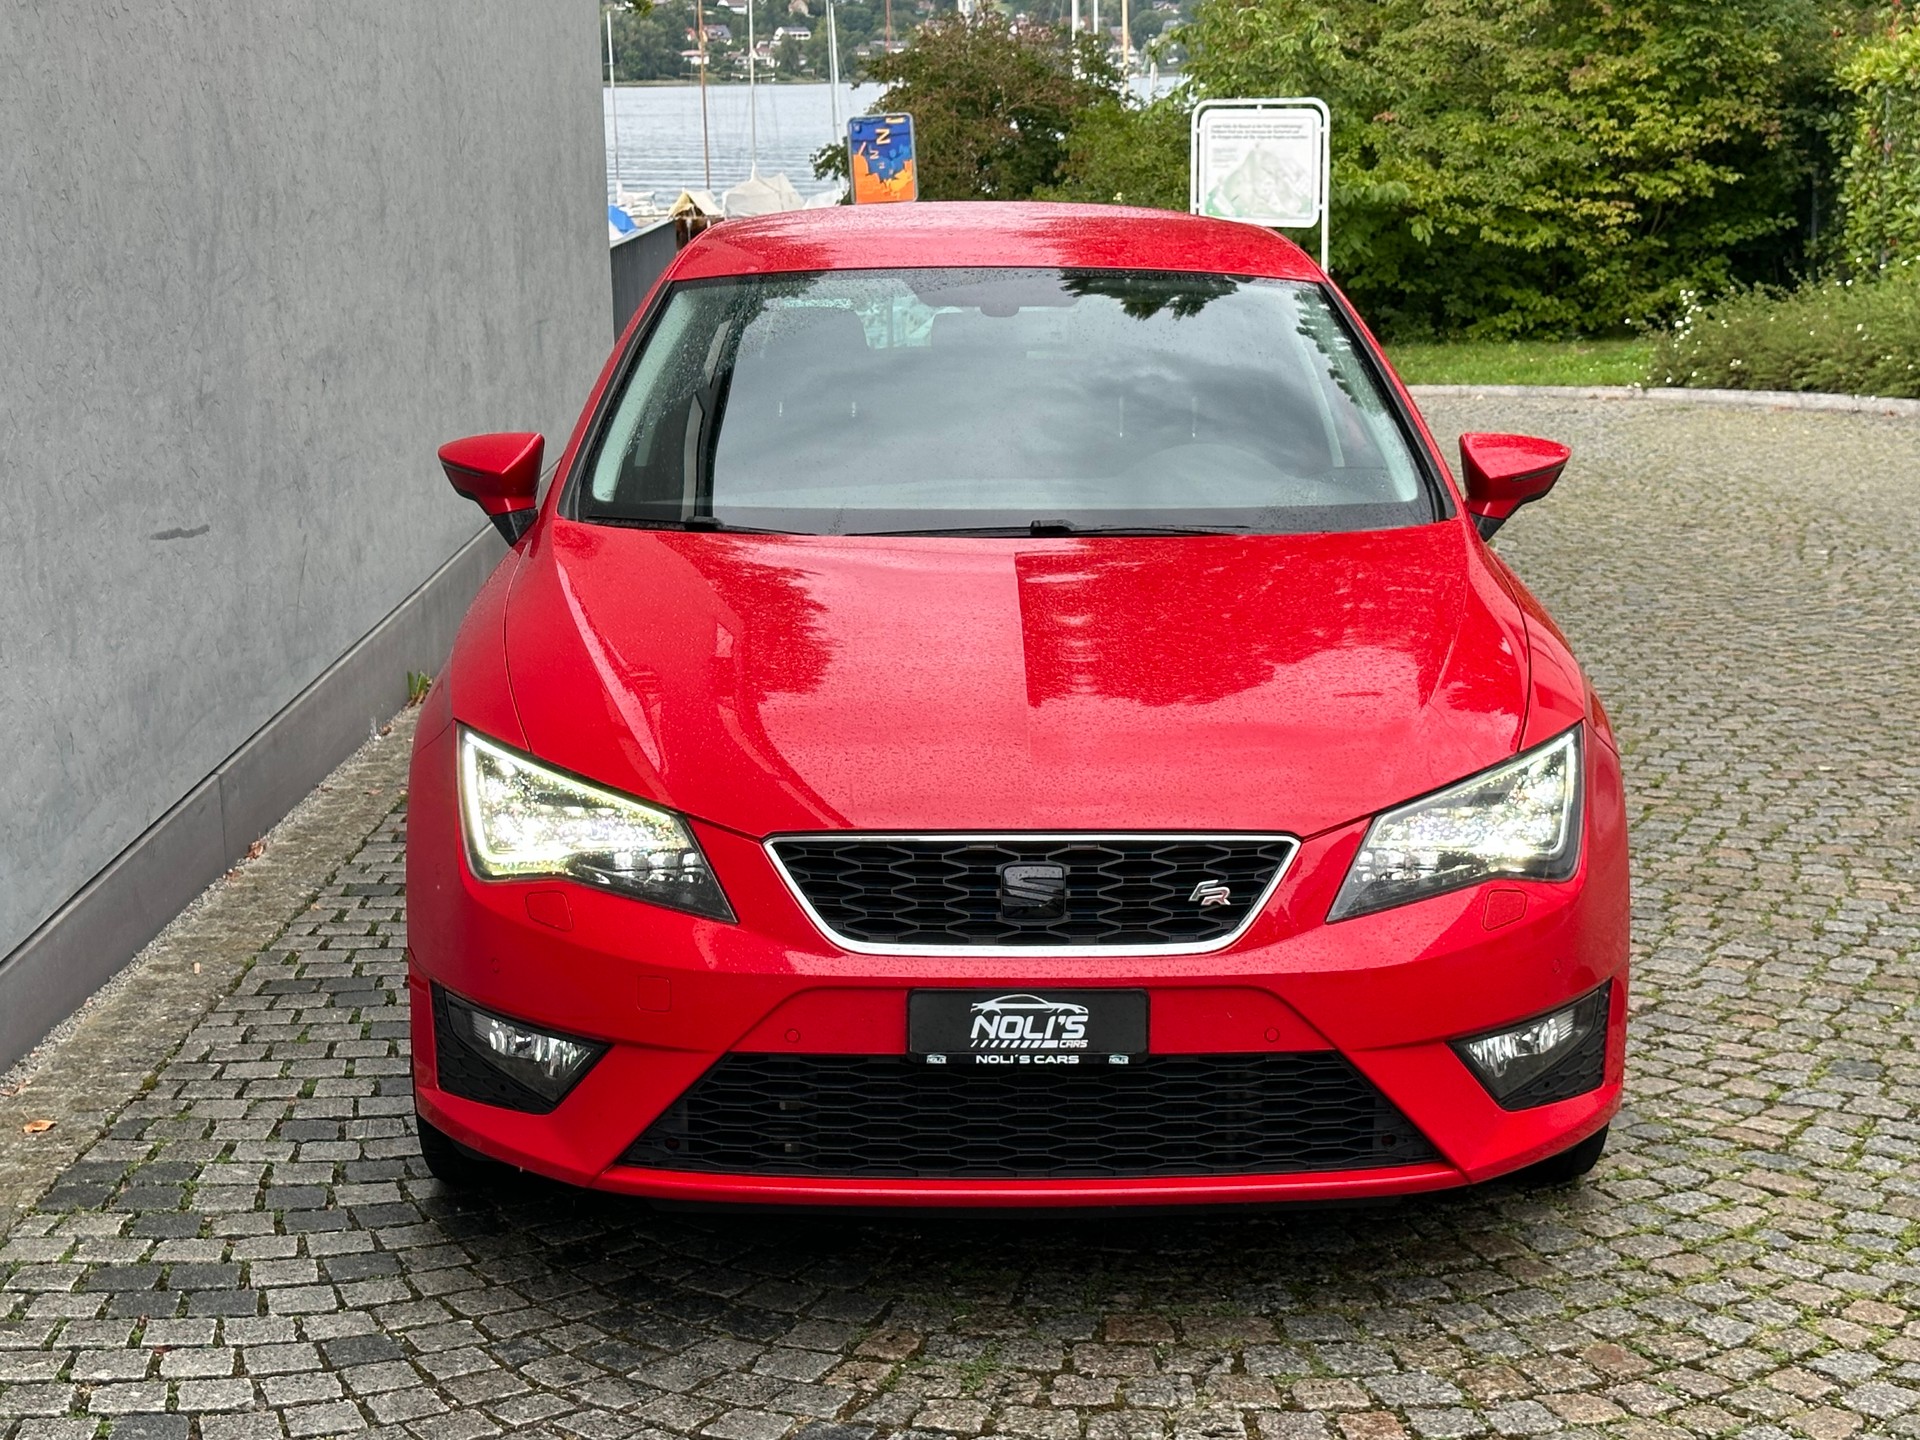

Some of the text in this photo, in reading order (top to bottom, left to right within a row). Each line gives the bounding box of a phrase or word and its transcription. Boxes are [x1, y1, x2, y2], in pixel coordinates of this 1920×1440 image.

[1188, 879, 1231, 906] FR
[970, 1014, 1089, 1039] NOLI'S
[1058, 1039, 1089, 1048] CARS
[1034, 1054, 1080, 1064] CARS
